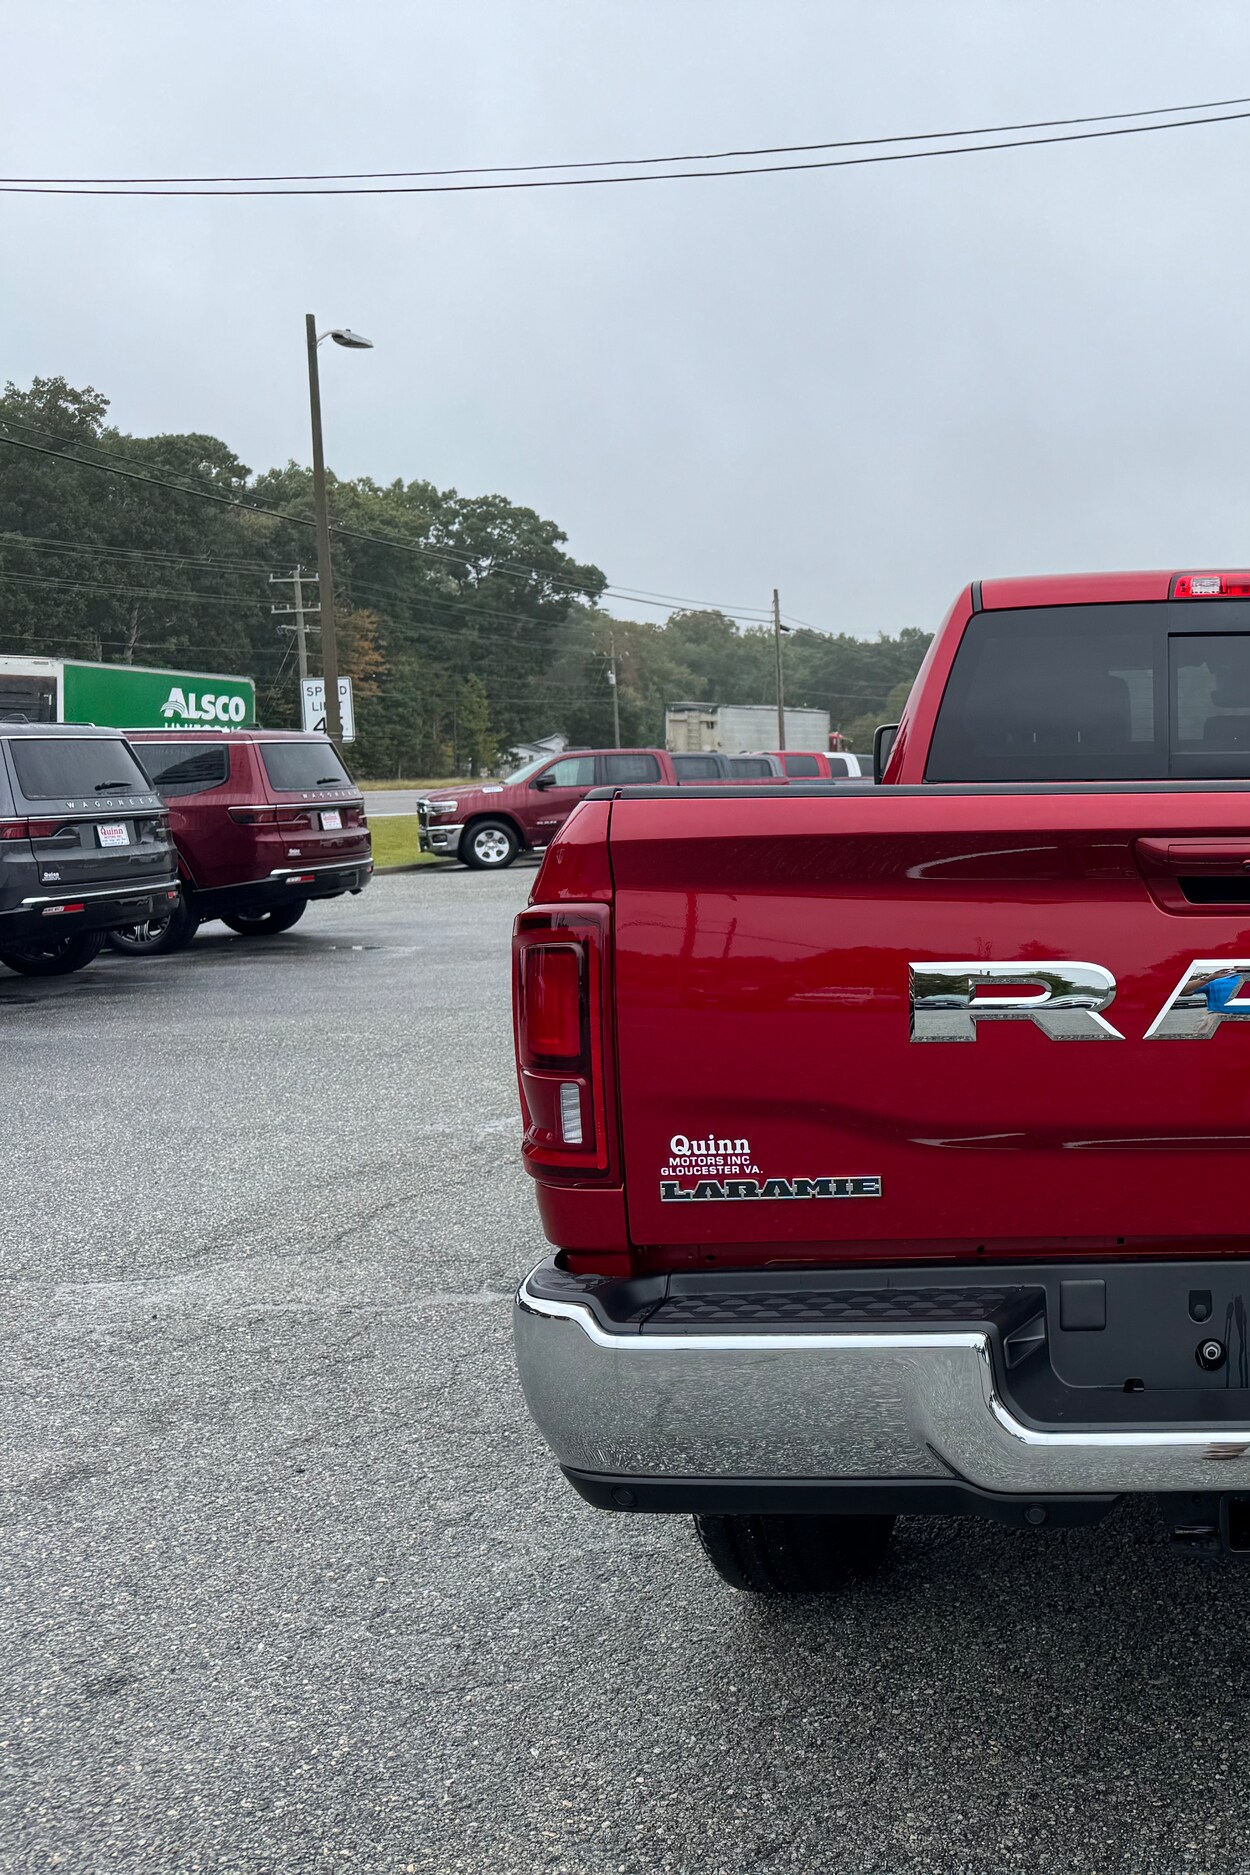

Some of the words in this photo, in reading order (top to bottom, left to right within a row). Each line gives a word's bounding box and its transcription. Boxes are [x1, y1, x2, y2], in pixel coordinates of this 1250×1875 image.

[306, 686, 347, 697] SPD
[161, 687, 246, 722] ALSCO
[670, 1134, 751, 1156] Quinn
[669, 1156, 724, 1166] MOTORS
[727, 1155, 750, 1165] INC
[660, 1165, 740, 1176] GLOUCESTER
[743, 1165, 764, 1175] VA.
[660, 1176, 882, 1202] LARAMIE
